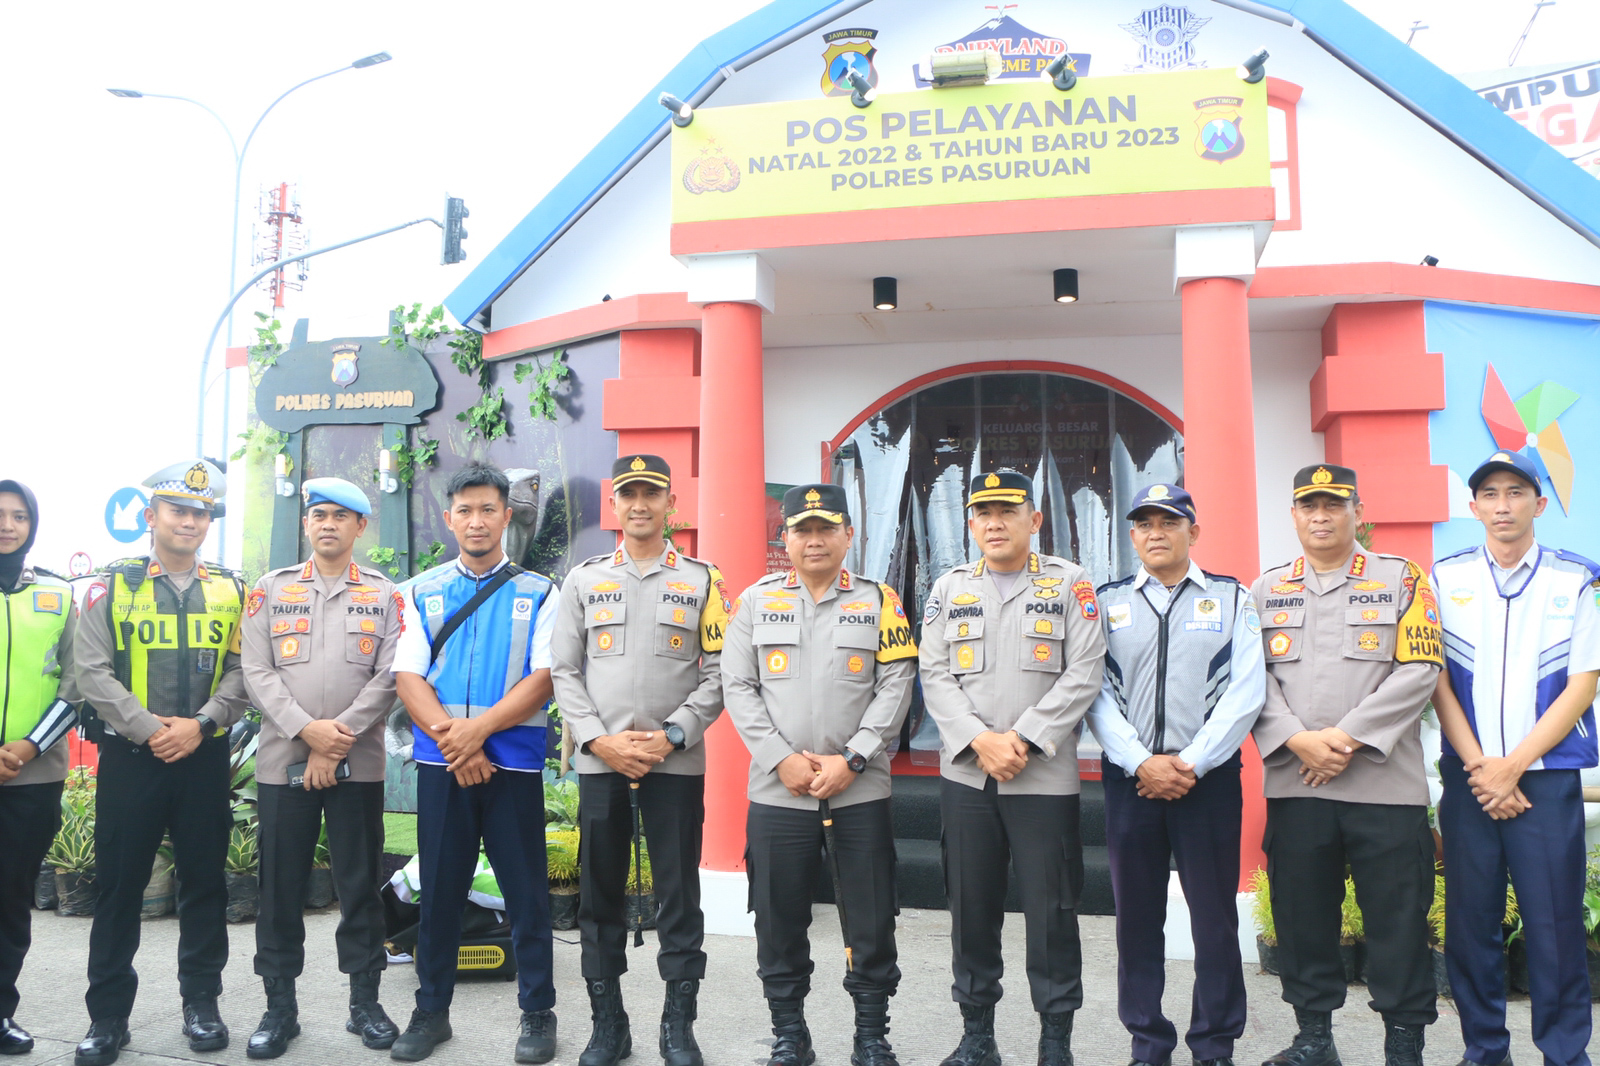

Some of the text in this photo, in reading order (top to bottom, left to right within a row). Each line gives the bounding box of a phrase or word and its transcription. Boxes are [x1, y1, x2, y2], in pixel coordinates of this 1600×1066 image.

[828, 30, 873, 40] JAWA TIMUR
[1198, 97, 1238, 108] JAWA TIMUR
[786, 95, 1137, 147] POS PELAYANAN
[748, 126, 1180, 174] NATAL 2022 & TAHUN BARU 2023
[831, 156, 1091, 191] POLRES PASURUAN
[275, 390, 415, 411] POLRES PASURUAN
[983, 421, 1099, 434] KELUARGA BESAR
[588, 593, 622, 604] BAYU
[662, 593, 697, 607] POLRI
[1349, 593, 1393, 604] POLRI
[272, 605, 311, 615] TAUFIK
[348, 606, 384, 616] POLRI
[948, 606, 984, 620] ADEWIRA
[1025, 602, 1064, 615] POLRI
[761, 613, 795, 623] TONI
[838, 615, 876, 625] POLRI
[1185, 621, 1221, 631] DISHUB
